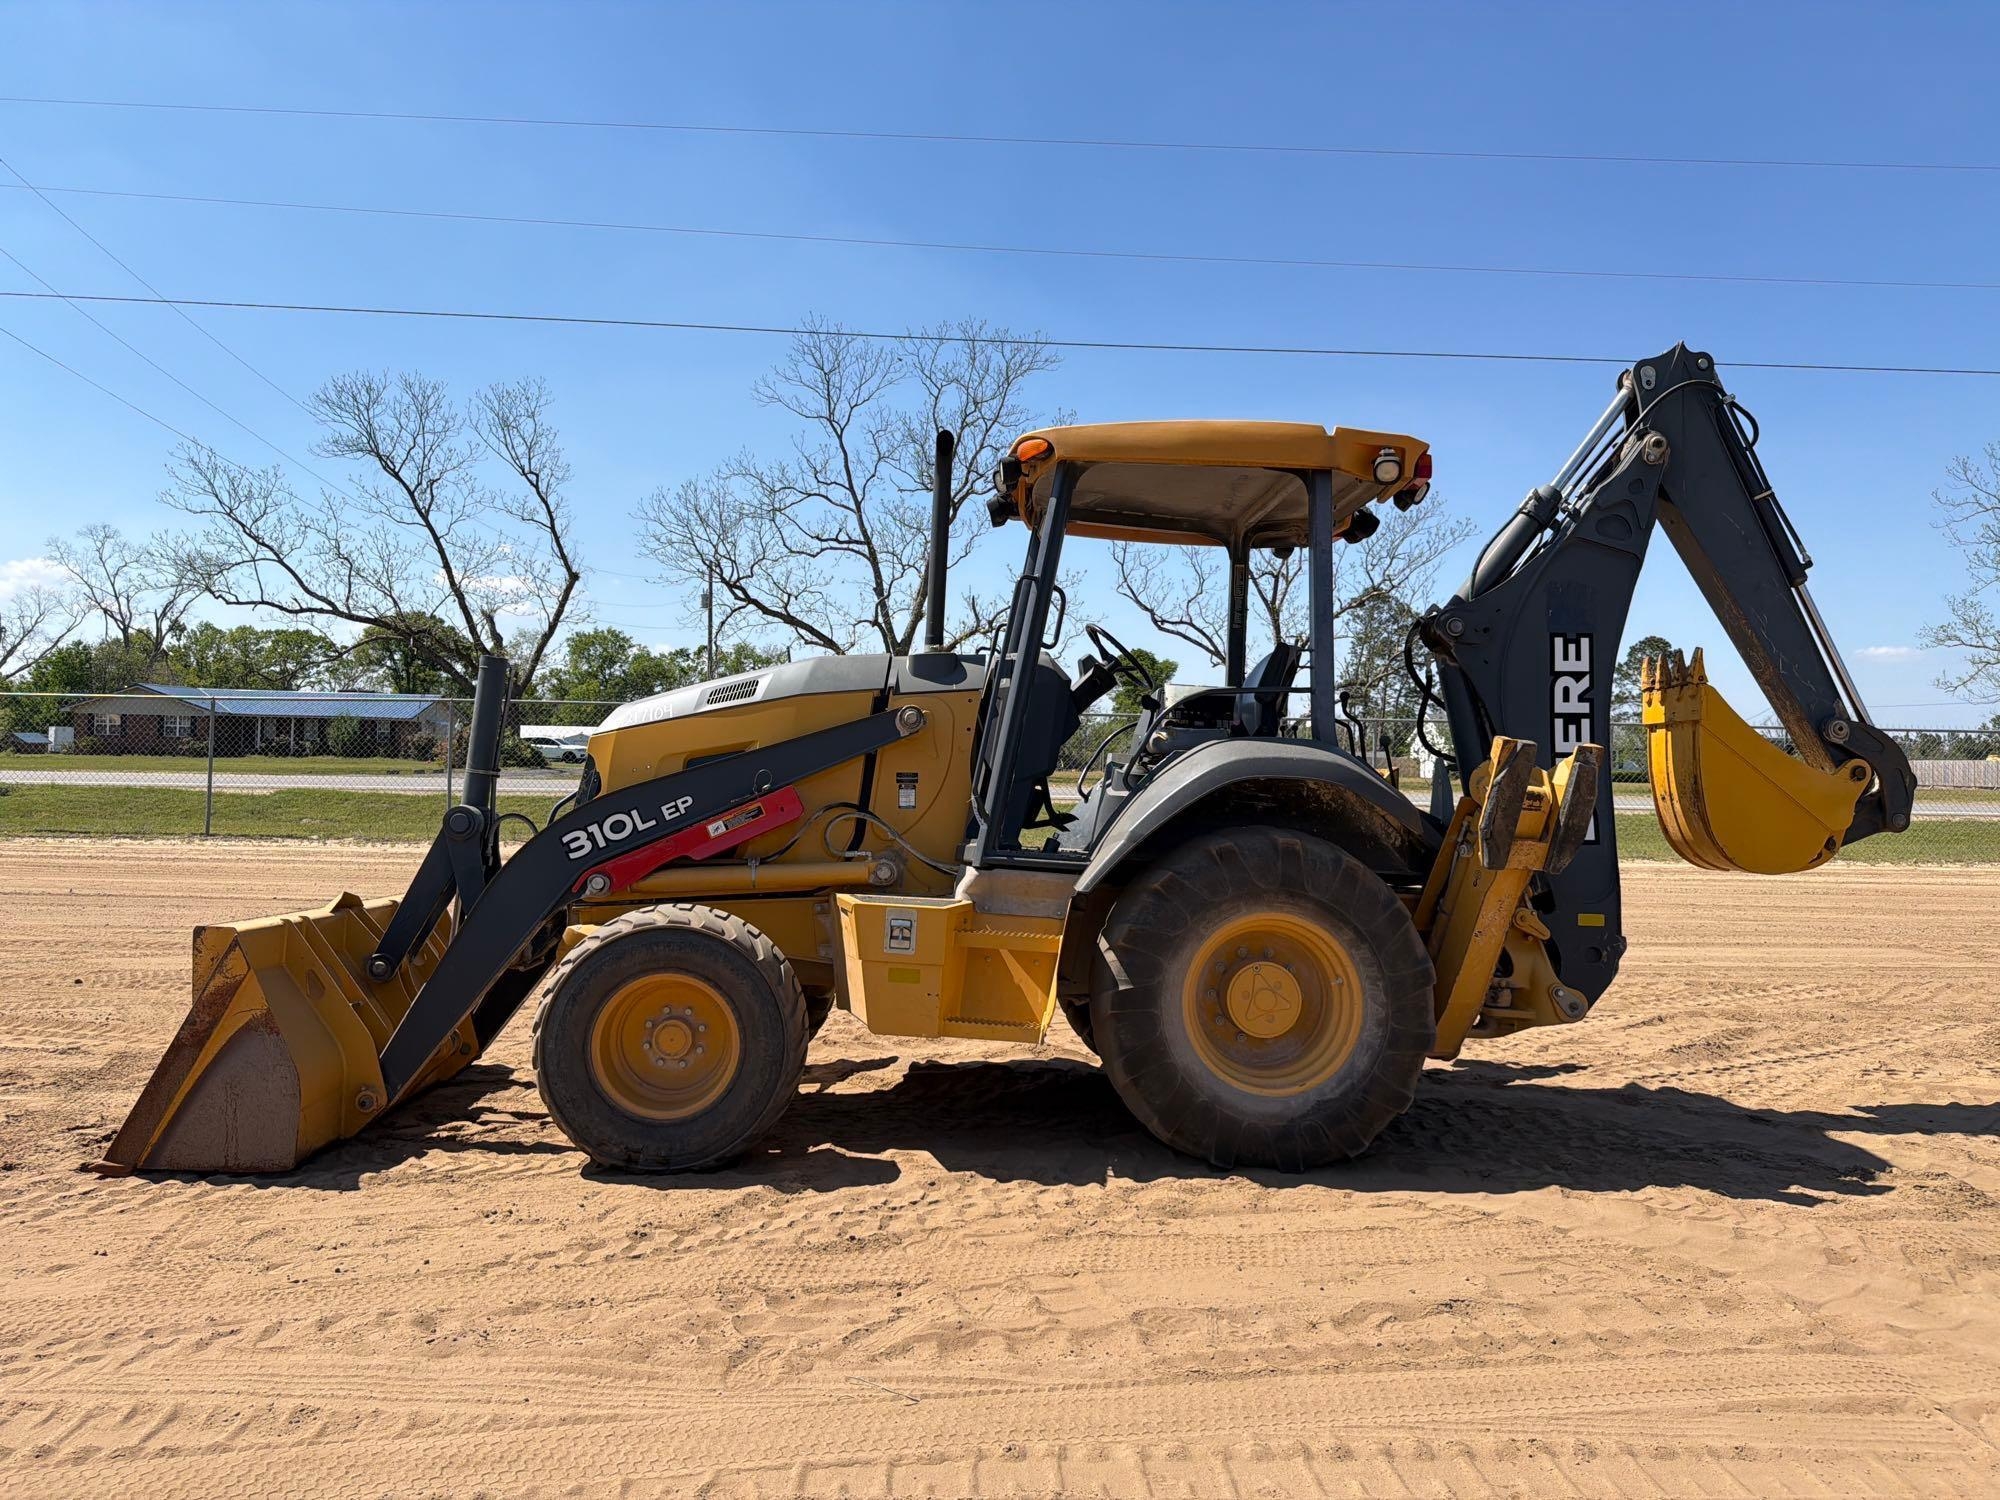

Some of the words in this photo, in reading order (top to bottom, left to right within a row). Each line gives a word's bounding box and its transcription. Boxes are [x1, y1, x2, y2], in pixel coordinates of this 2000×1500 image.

[1553, 636, 1596, 841] ERE
[561, 809, 656, 860] 310L
[661, 795, 694, 821] EP
